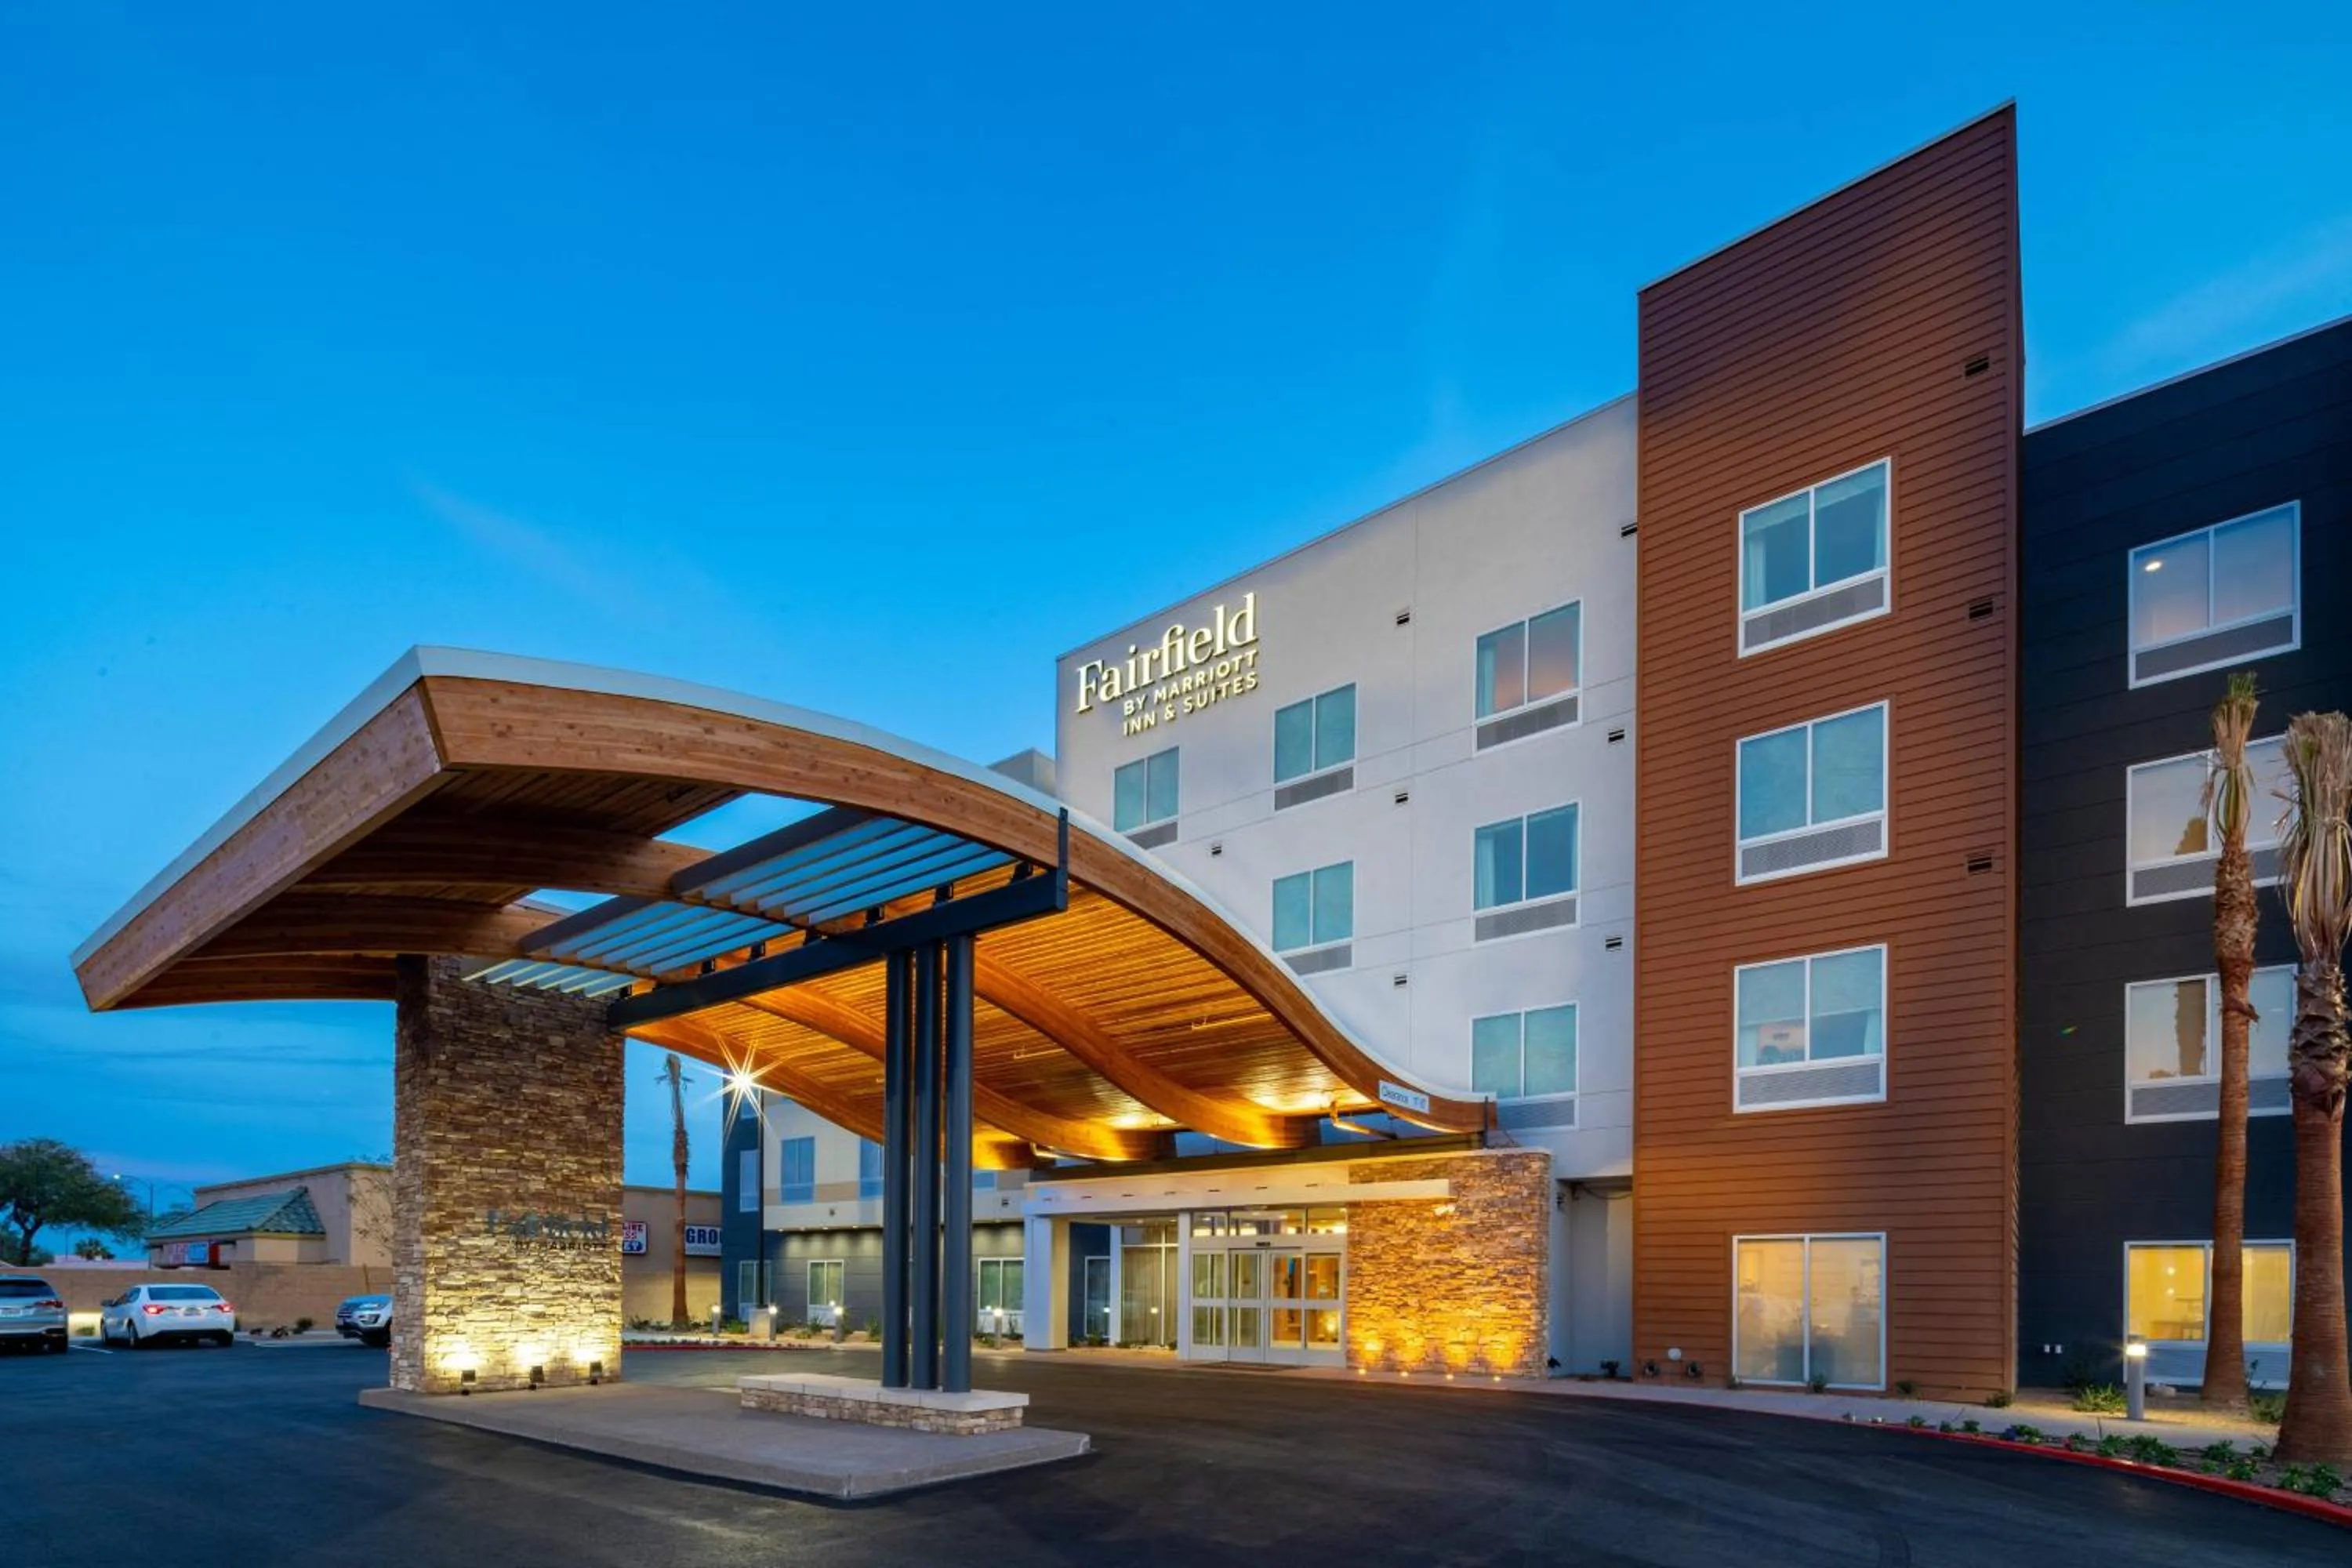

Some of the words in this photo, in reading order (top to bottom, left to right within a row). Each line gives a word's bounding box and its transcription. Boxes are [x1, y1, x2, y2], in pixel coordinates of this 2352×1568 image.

[1076, 592, 1258, 713] Fairfield
[1123, 695, 1148, 717] BY
[1153, 649, 1258, 705] MARRIOTT
[1123, 710, 1157, 736] INN
[1164, 704, 1177, 721] &
[1183, 672, 1258, 713] SUITES
